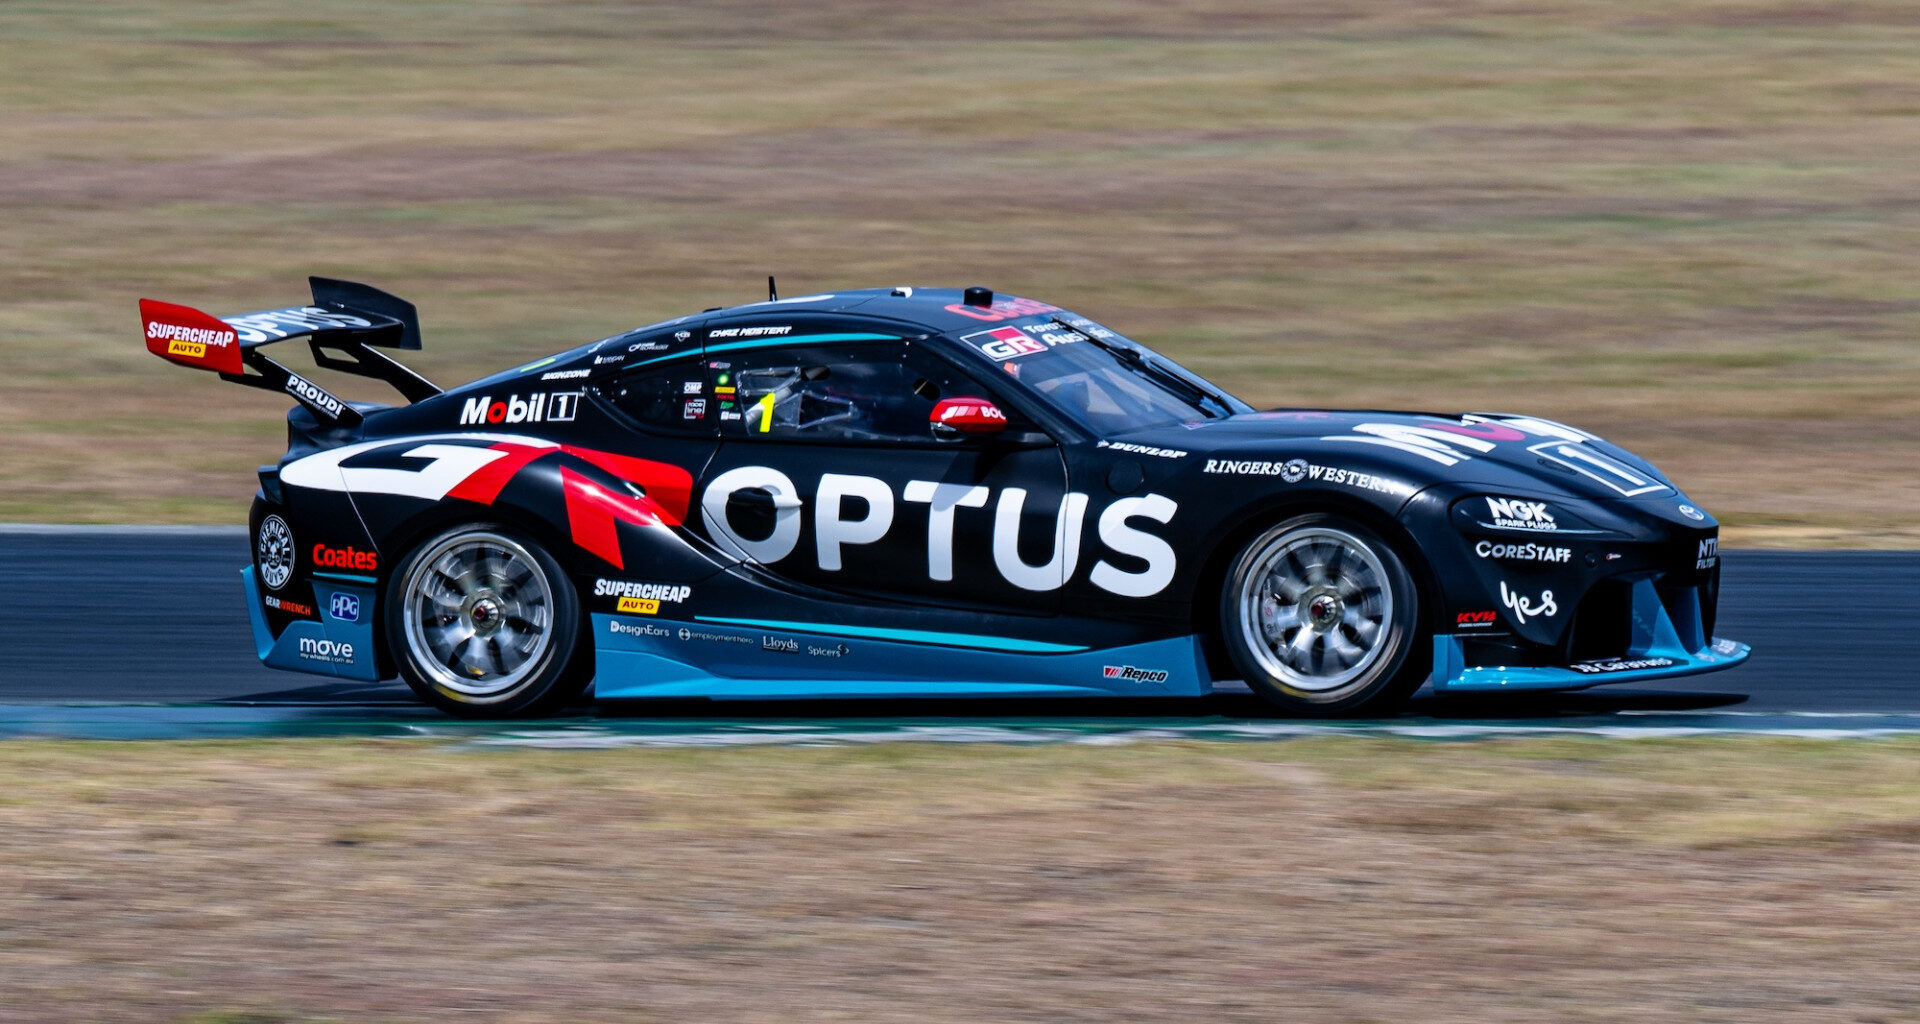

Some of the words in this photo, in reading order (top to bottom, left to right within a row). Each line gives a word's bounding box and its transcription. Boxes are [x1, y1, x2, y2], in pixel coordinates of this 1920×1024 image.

[147, 321, 234, 347] SUPERCHEAP
[709, 329, 740, 338] CHAZ
[739, 326, 792, 337] MOSTERT
[172, 343, 202, 355] AUTO
[982, 335, 1041, 358] GR
[287, 374, 343, 416] PROUDI
[460, 393, 546, 425] Mobil
[558, 394, 569, 419] 1
[759, 392, 775, 433] 1
[1108, 442, 1188, 459] DUNLOP
[1203, 459, 1283, 476] RINGERS
[1308, 464, 1398, 495] WESTERN
[1485, 496, 1554, 523] NGK
[702, 465, 1178, 598] OPTUS
[1495, 519, 1526, 528] SPARK
[1527, 521, 1557, 530] PLUGS
[260, 520, 290, 556] CHEMICAL
[312, 543, 377, 570] Coates
[264, 567, 284, 584] GUYS
[594, 578, 691, 604] SUPERCHEAP
[265, 595, 312, 616] GEARWRENCH
[332, 595, 358, 617] PPG
[622, 601, 655, 611] AUTO
[1500, 580, 1558, 625] yes
[1456, 610, 1497, 623] KYB
[610, 621, 670, 638] DesignEars
[300, 637, 354, 658] move
[762, 635, 799, 651] Lloyds
[808, 645, 841, 658] Spicers
[1121, 666, 1168, 683] Repco
